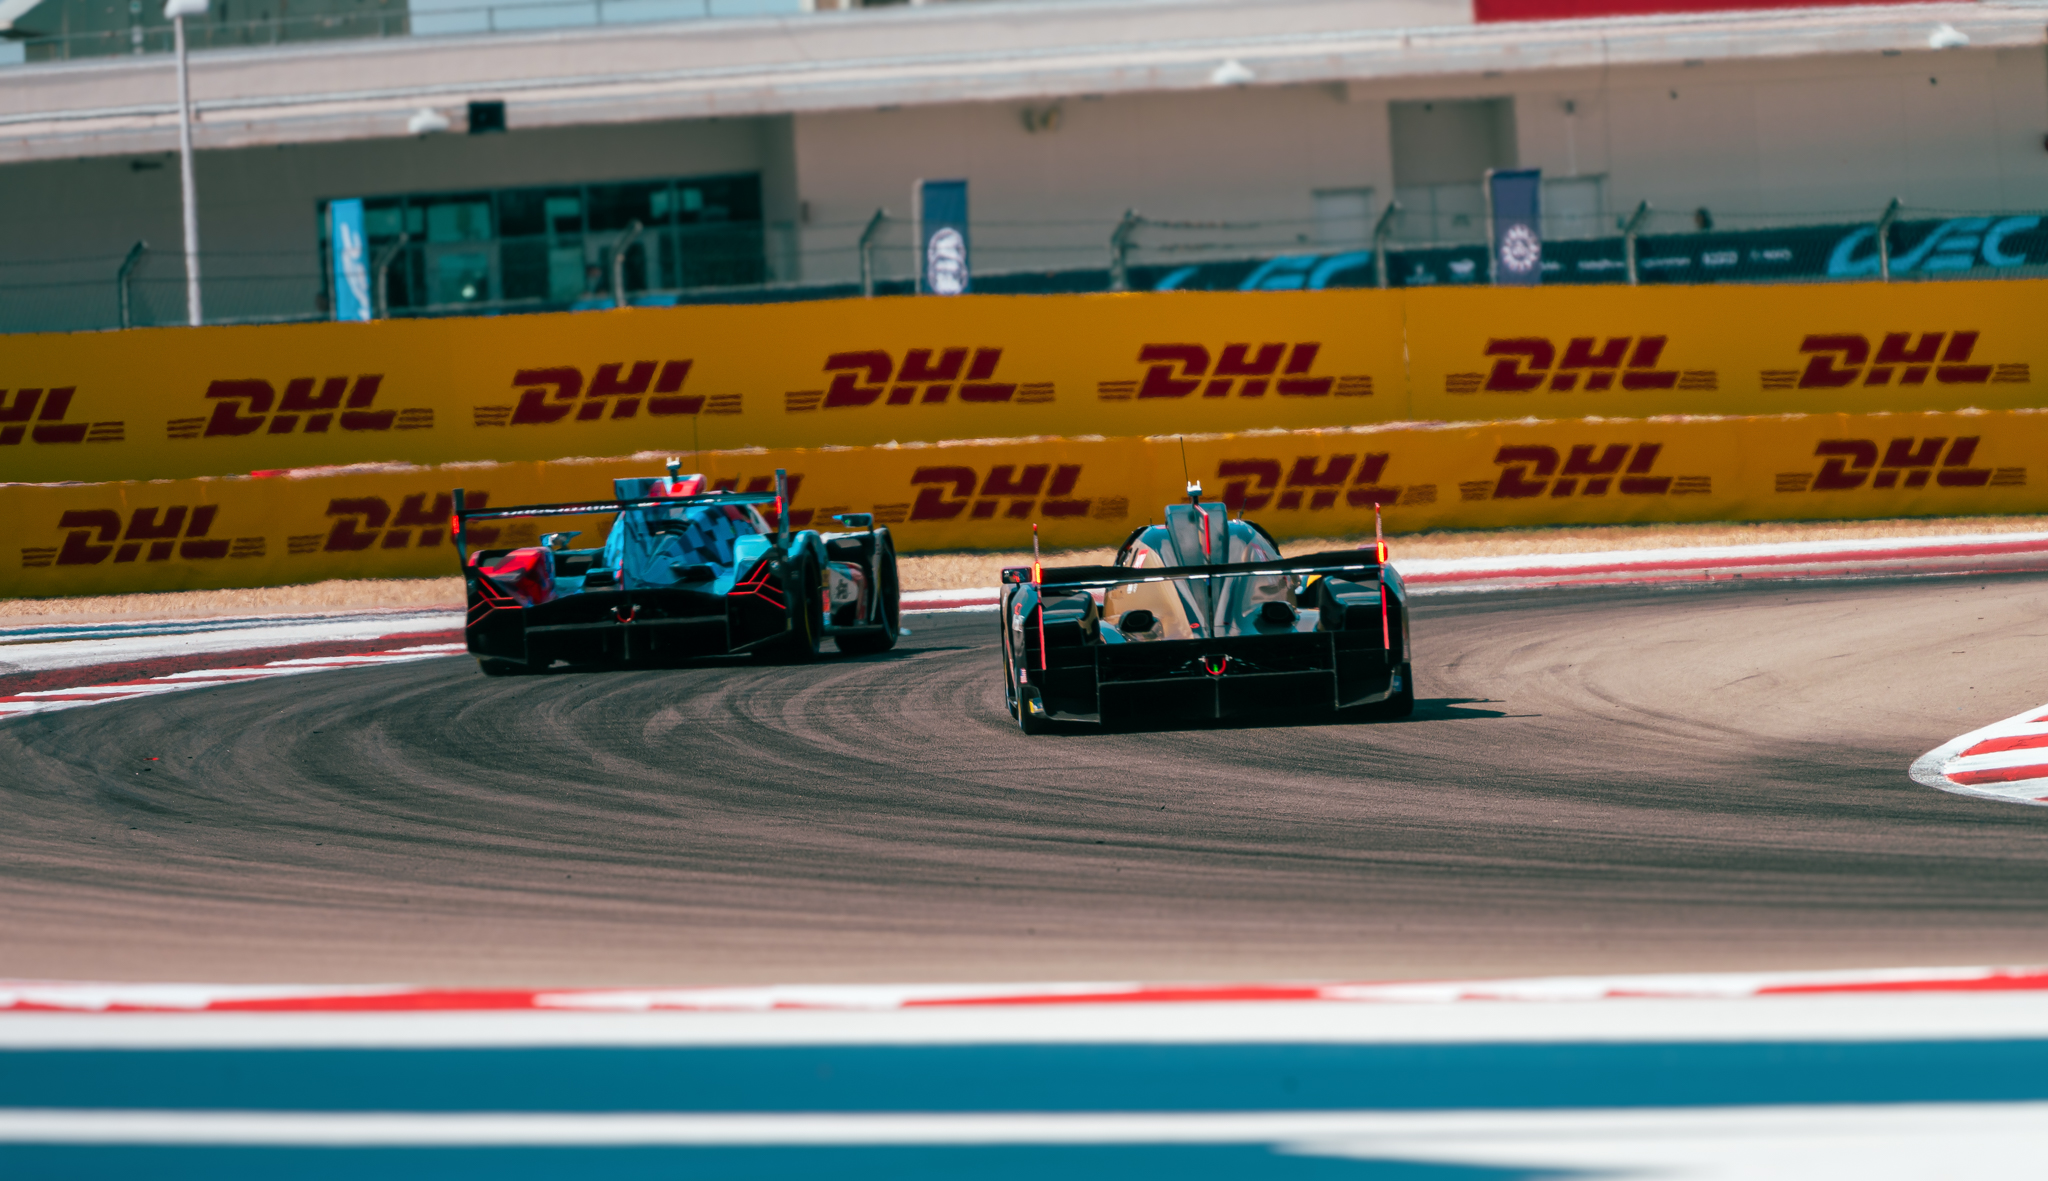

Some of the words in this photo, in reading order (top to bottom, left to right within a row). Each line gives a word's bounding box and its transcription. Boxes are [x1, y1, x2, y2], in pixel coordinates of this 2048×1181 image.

[823, 349, 1017, 408] DHL
[1138, 344, 1333, 399] DHL
[1485, 337, 1677, 392] DHL
[1798, 332, 1992, 388] DHL
[0, 387, 89, 446] HL
[204, 375, 397, 438] DHL
[511, 361, 706, 425] DHL
[909, 464, 1091, 521] DHL
[1218, 453, 1399, 512] DHL
[1493, 444, 1671, 499] DHL
[1813, 437, 1991, 490] DHL
[55, 505, 230, 566] DHL
[323, 492, 501, 552] DHL
